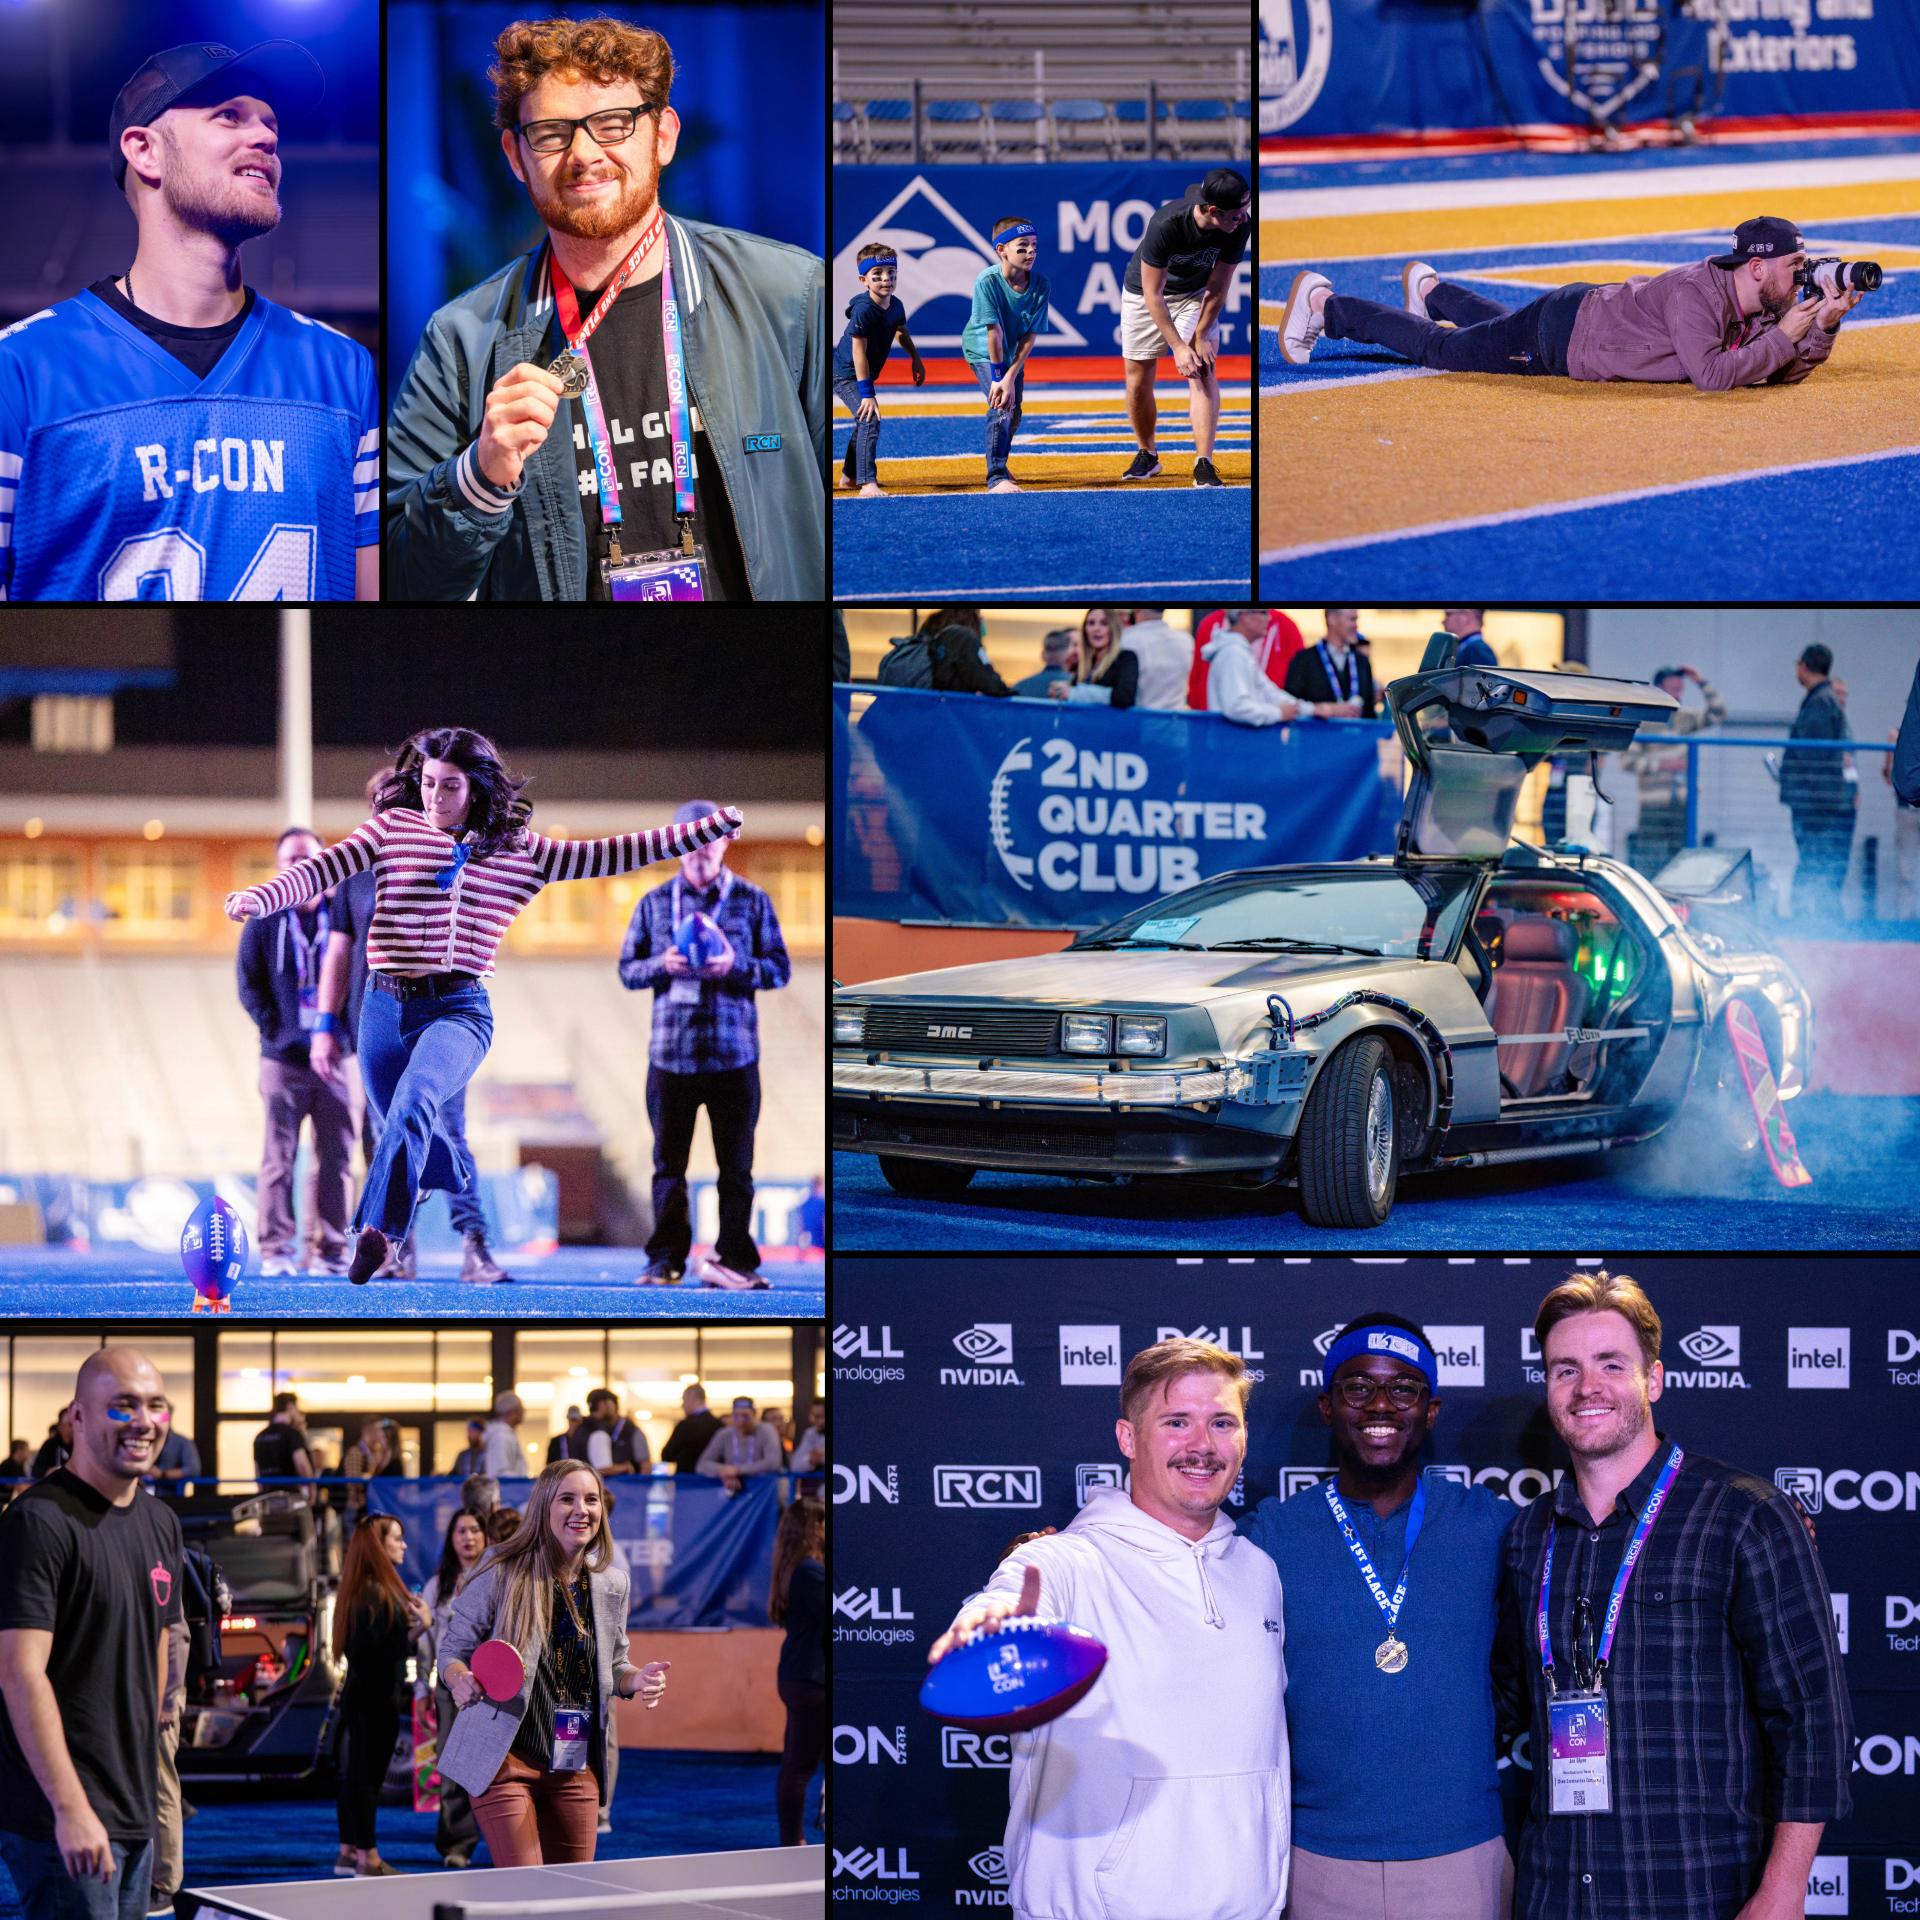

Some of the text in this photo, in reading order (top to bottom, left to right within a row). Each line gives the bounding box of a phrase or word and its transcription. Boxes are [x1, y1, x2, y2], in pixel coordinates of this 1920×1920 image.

[628, 228, 655, 272] PLACE
[601, 284, 616, 312] 2ND
[664, 300, 678, 332] RCN
[674, 441, 689, 478] RCN
[748, 434, 780, 452] RCN
[135, 437, 285, 502] R-CON
[1041, 738, 1149, 791] 2ND
[1038, 794, 1267, 841] QUARTER
[1038, 841, 1201, 893] CLUB
[1434, 1346, 1481, 1367] ntel.
[941, 1472, 1035, 1507] RCN
[1624, 1539, 1643, 1565] RCN
[1350, 1541, 1367, 1566] 1ST
[1361, 1563, 1391, 1610] PLACE
[833, 1585, 914, 1621] ELL
[1390, 1584, 1407, 1624] LACE
[950, 1734, 1010, 1768] RC
[1569, 1738, 1587, 1747] CON
[955, 1890, 1010, 1906] NVID
